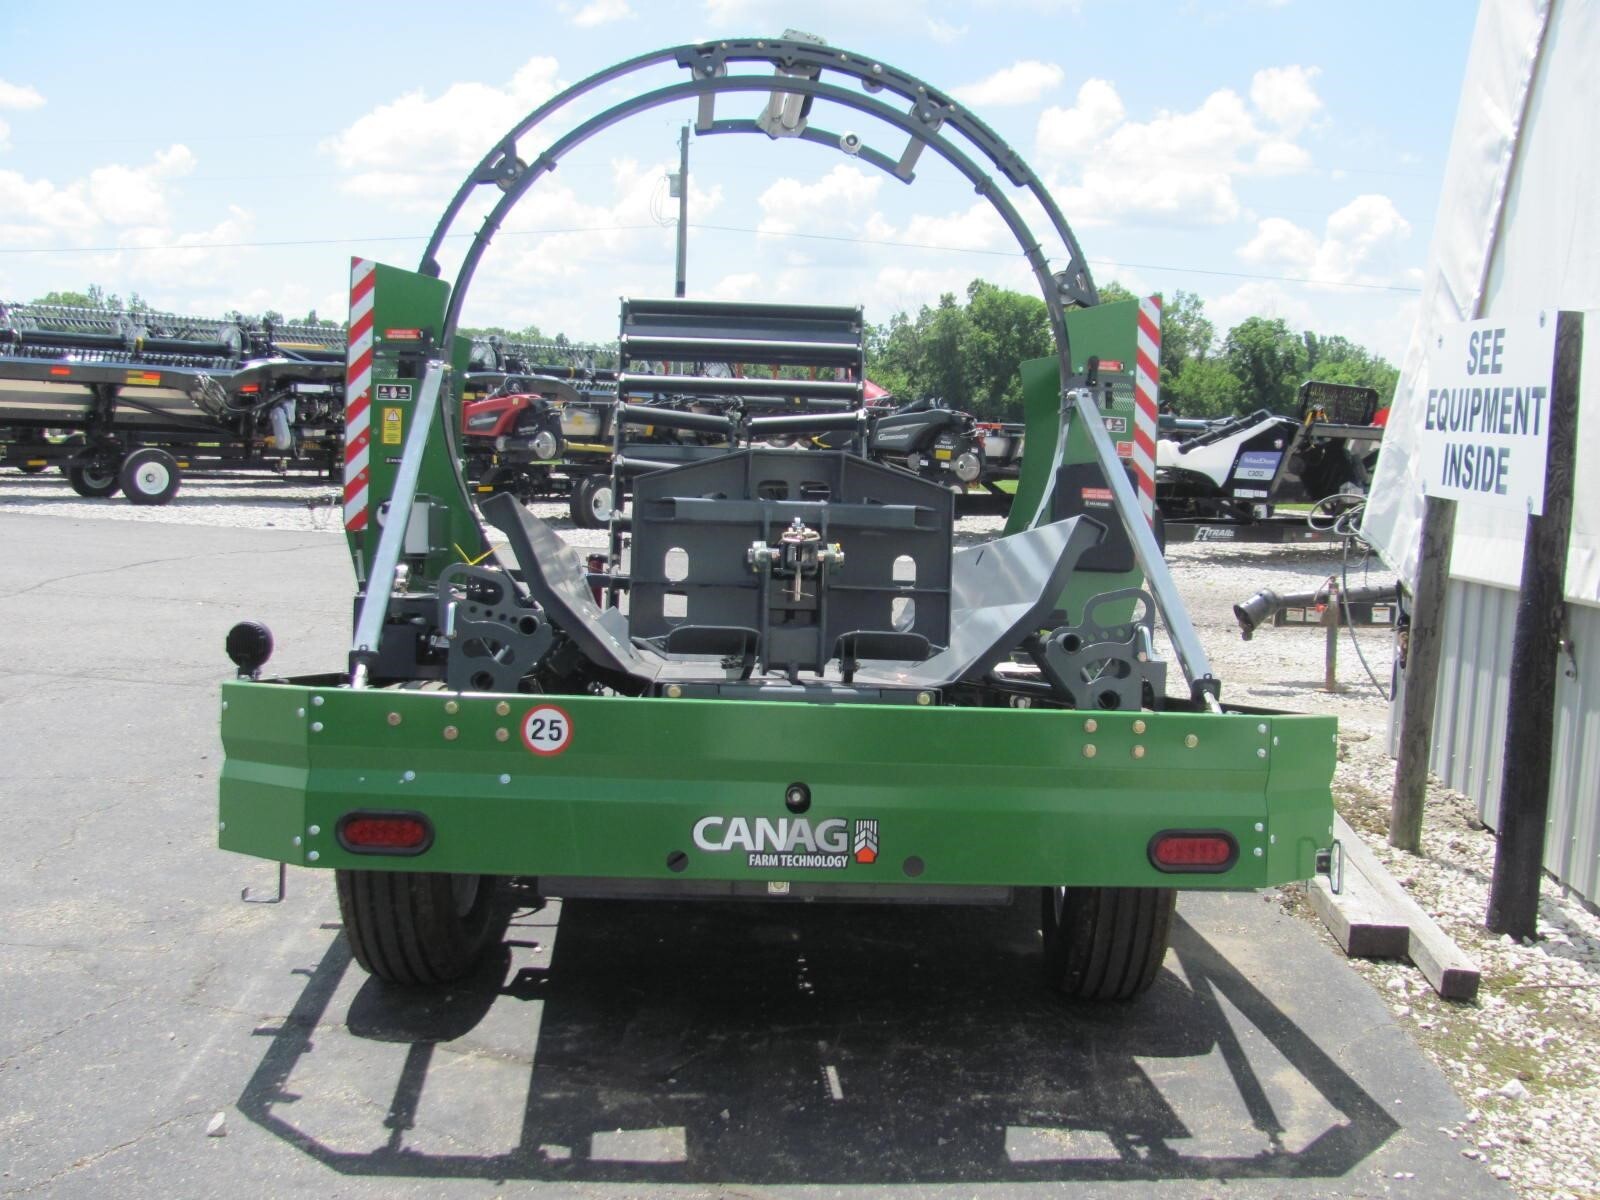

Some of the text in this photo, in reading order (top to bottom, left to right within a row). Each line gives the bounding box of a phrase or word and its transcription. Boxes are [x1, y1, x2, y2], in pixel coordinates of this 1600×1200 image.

[1467, 328, 1506, 376] SEE
[1425, 386, 1547, 436] EQUIPMENT
[1441, 442, 1511, 496] INSIDE
[531, 718, 563, 742] 25
[693, 816, 848, 853] CANAG
[749, 854, 849, 868] FARM TECHNOLOGY
